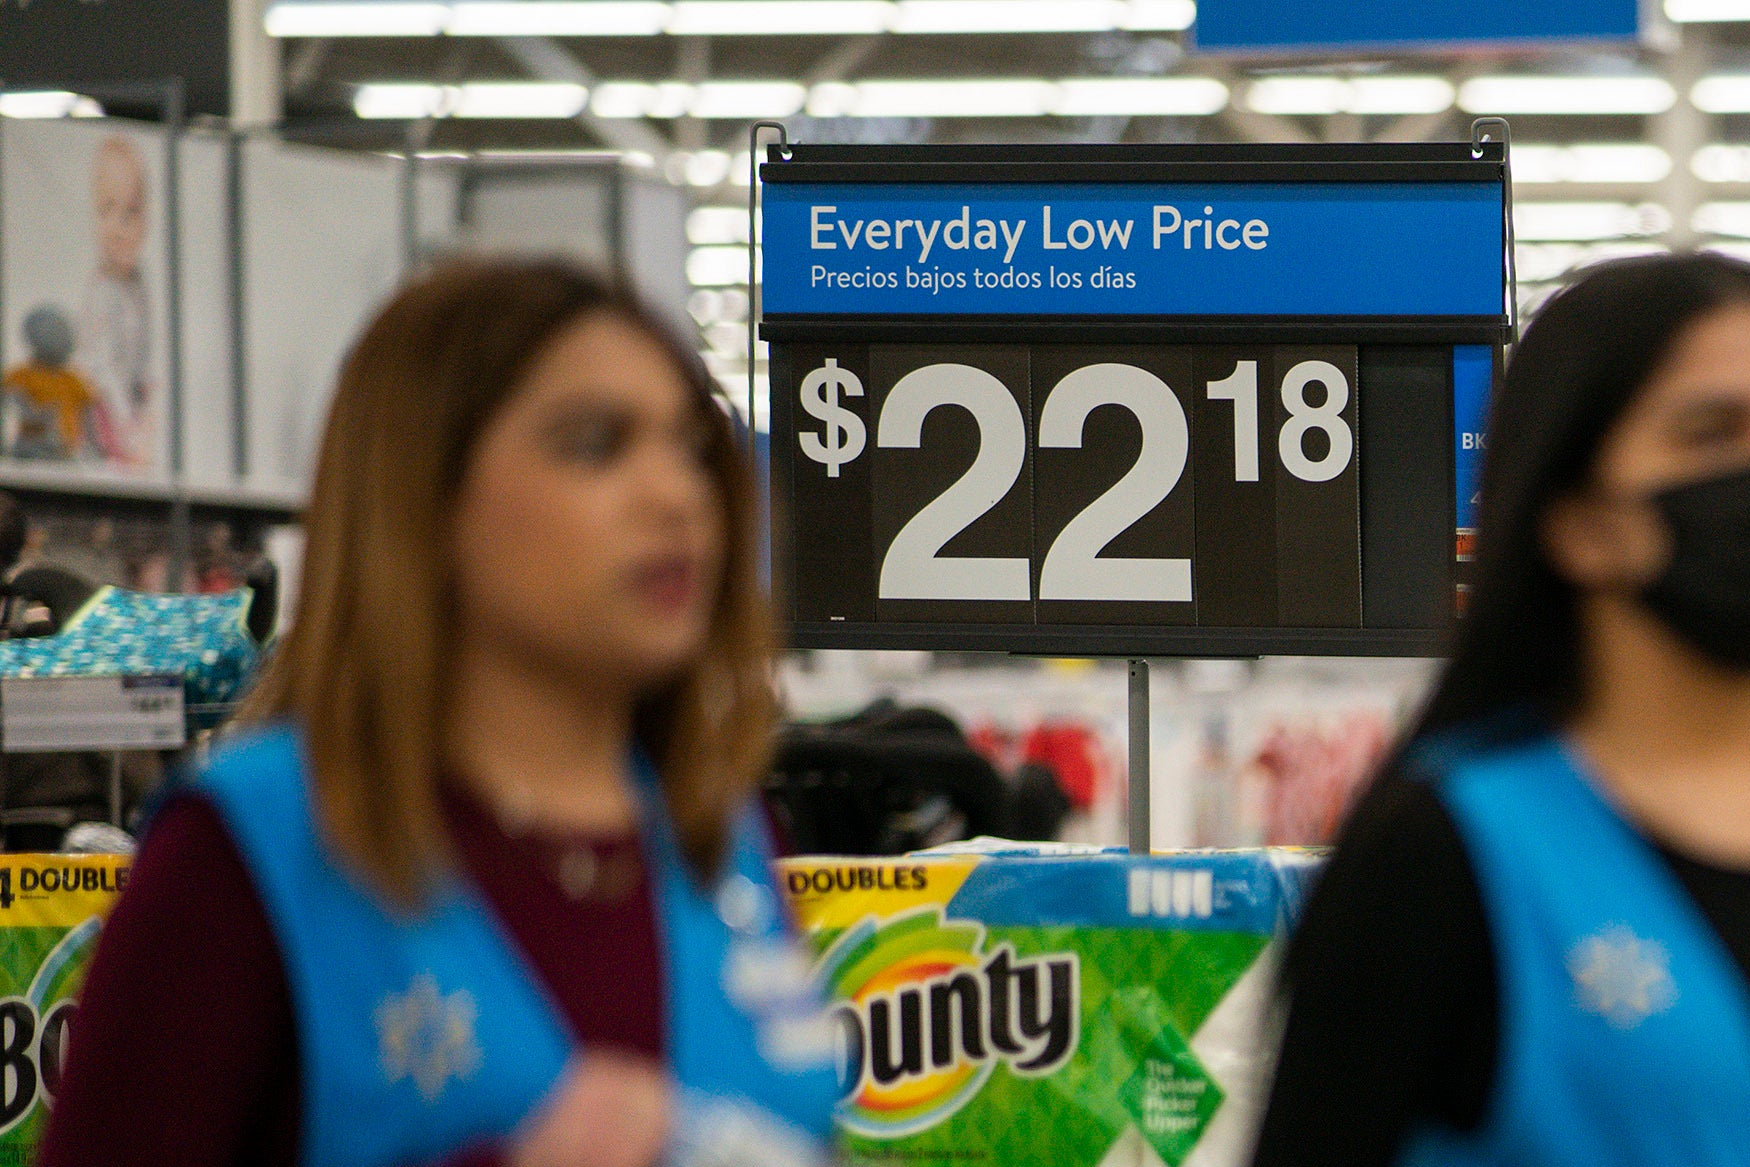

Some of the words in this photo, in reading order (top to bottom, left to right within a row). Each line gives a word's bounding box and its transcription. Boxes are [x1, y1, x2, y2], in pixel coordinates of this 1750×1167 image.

[810, 205, 1027, 263] Everyday
[1042, 205, 1134, 251] Low
[1152, 205, 1270, 251] Price
[811, 265, 899, 289] Precios
[906, 265, 967, 295] bajos
[974, 265, 1042, 289] todos
[1050, 265, 1083, 289] los
[1091, 265, 1137, 290] días
[788, 866, 928, 894] DOUBLES
